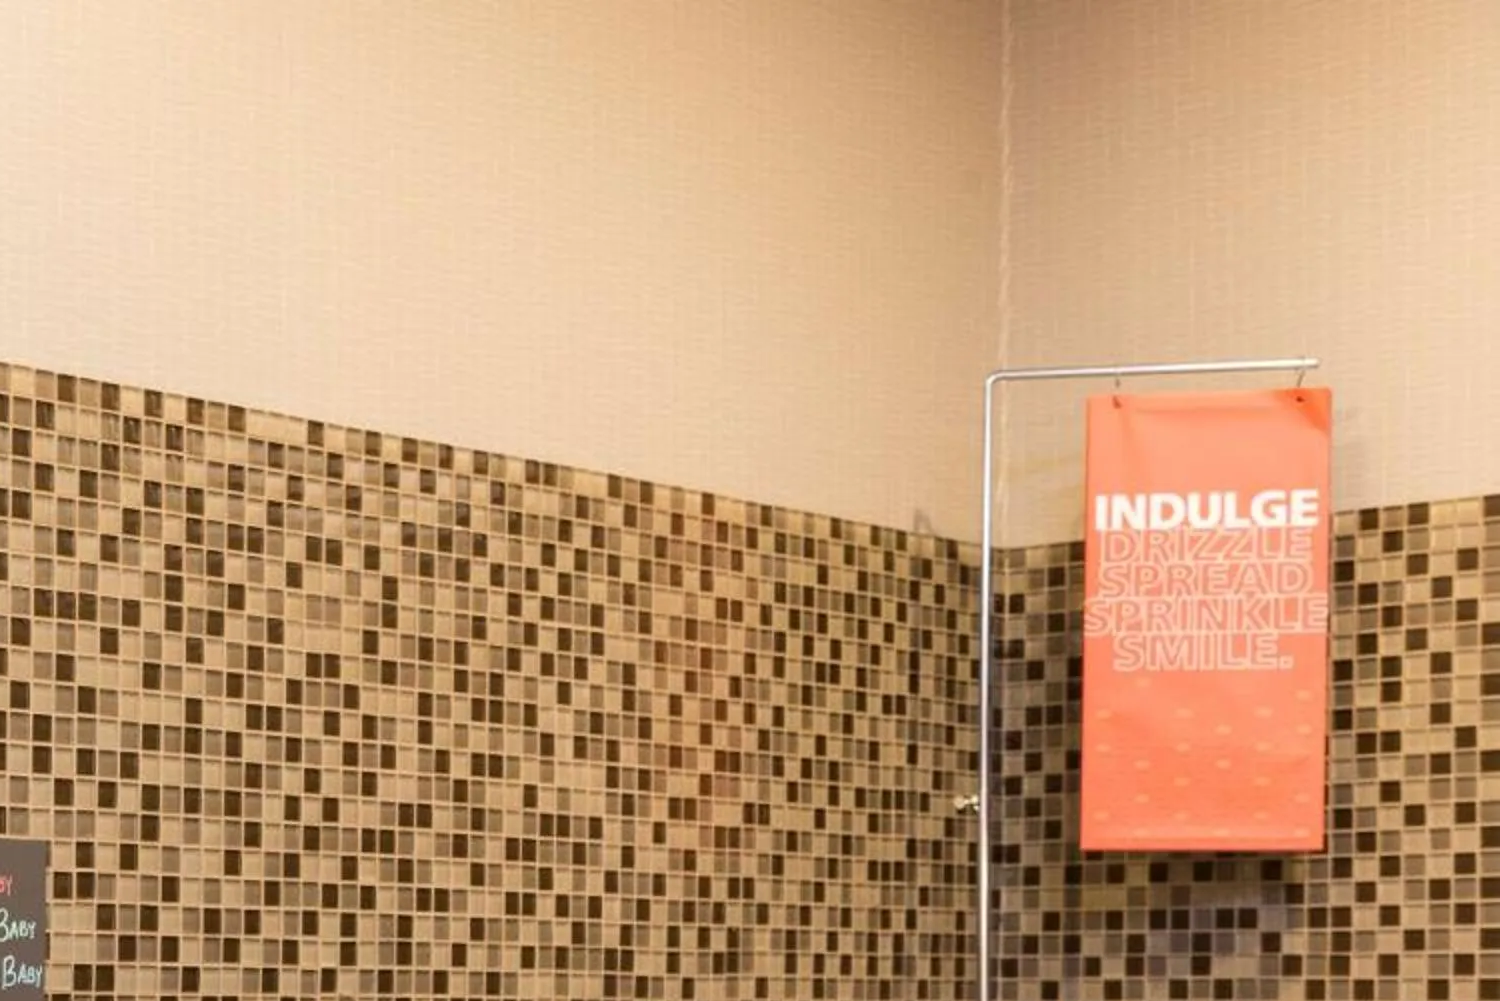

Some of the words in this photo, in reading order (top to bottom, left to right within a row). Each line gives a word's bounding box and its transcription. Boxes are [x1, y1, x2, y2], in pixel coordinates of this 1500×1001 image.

[1094, 488, 1320, 532] INDULGE
[1101, 526, 1313, 564] DRIZZLE
[1098, 560, 1314, 600] SPREAD
[1083, 593, 1329, 637] SPRINKLE
[1112, 630, 1294, 672] SMILE.
